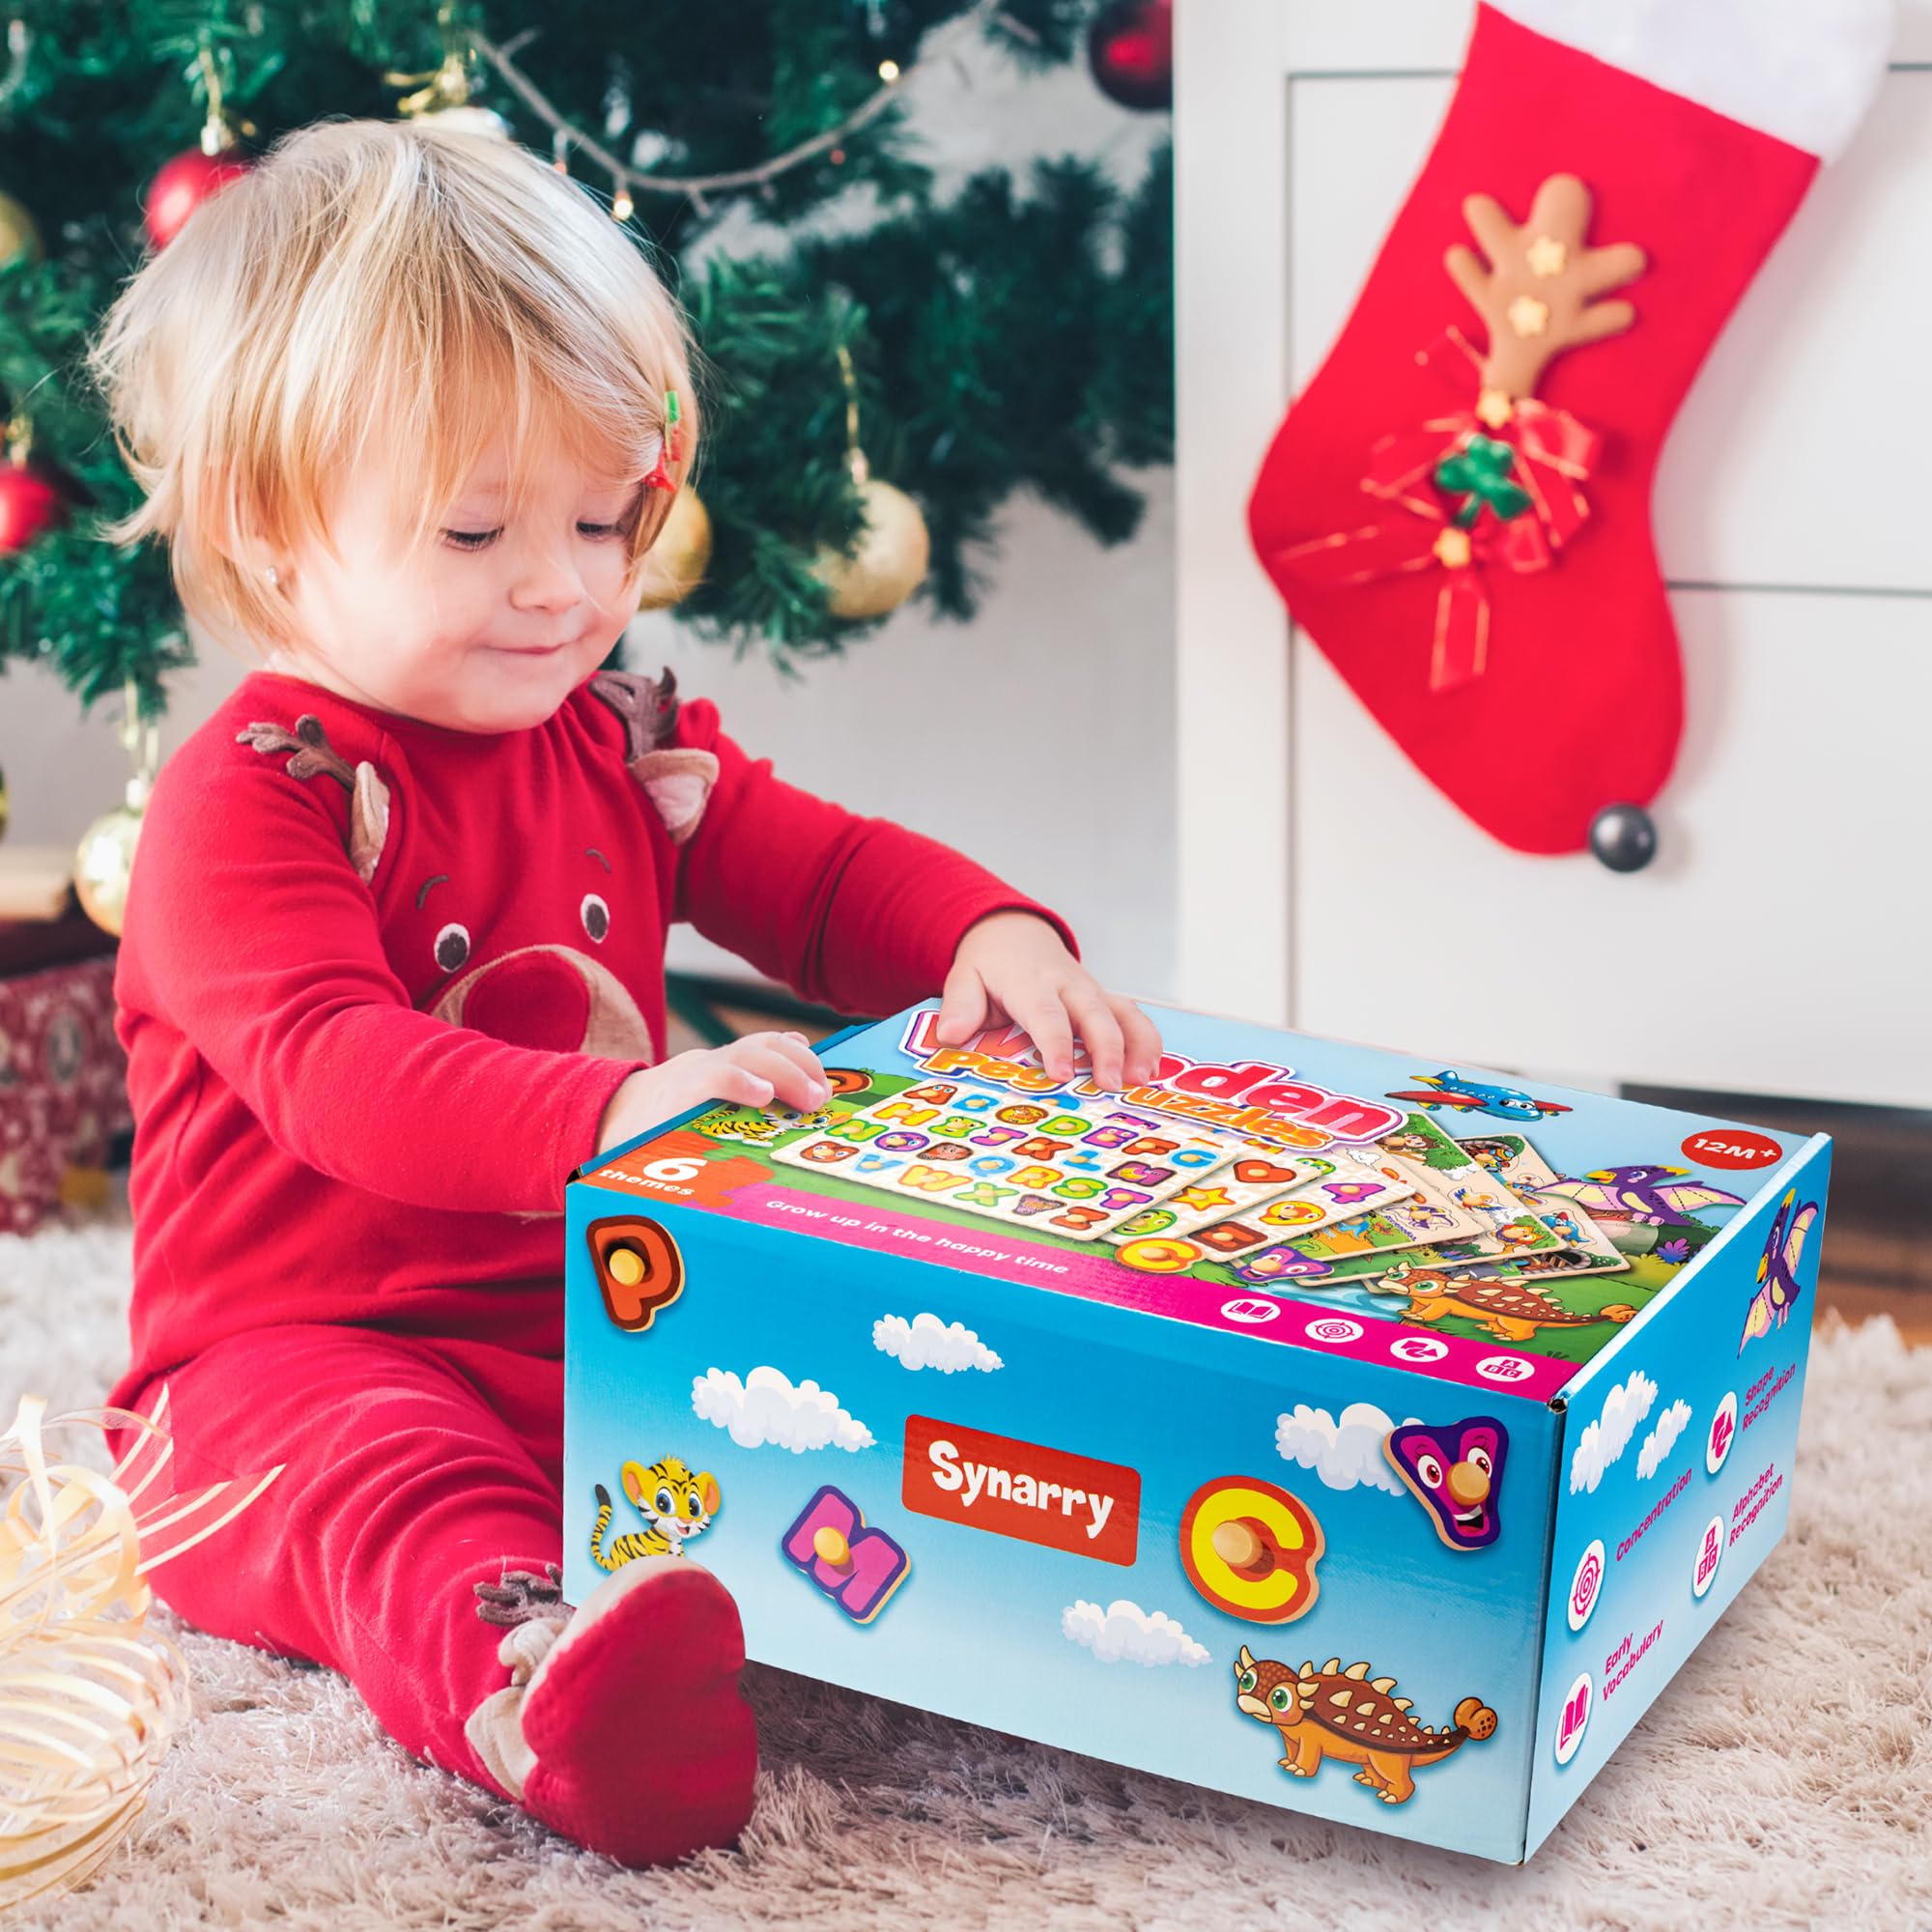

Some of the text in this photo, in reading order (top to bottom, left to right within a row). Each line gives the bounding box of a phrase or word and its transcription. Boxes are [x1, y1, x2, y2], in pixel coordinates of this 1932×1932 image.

[598, 1168, 696, 1196] themes
[642, 1157, 708, 1181] 6
[1693, 1139, 1777, 1159] 12M+
[585, 1214, 685, 1331] P
[765, 1200, 1069, 1274] Grow up in the happy time
[1742, 1362, 1796, 1433] Recognition
[1745, 1365, 1775, 1407] Shape
[928, 1439, 1115, 1540] Synarry
[1616, 1467, 1692, 1562] Concentration
[1728, 1473, 1783, 1548] Recognition
[1732, 1463, 1775, 1522] Alphabet
[781, 1485, 908, 1621] M
[1180, 1476, 1320, 1622] C
[1603, 1619, 1663, 1701] Vocabulary
[1605, 1633, 1634, 1676] Early
